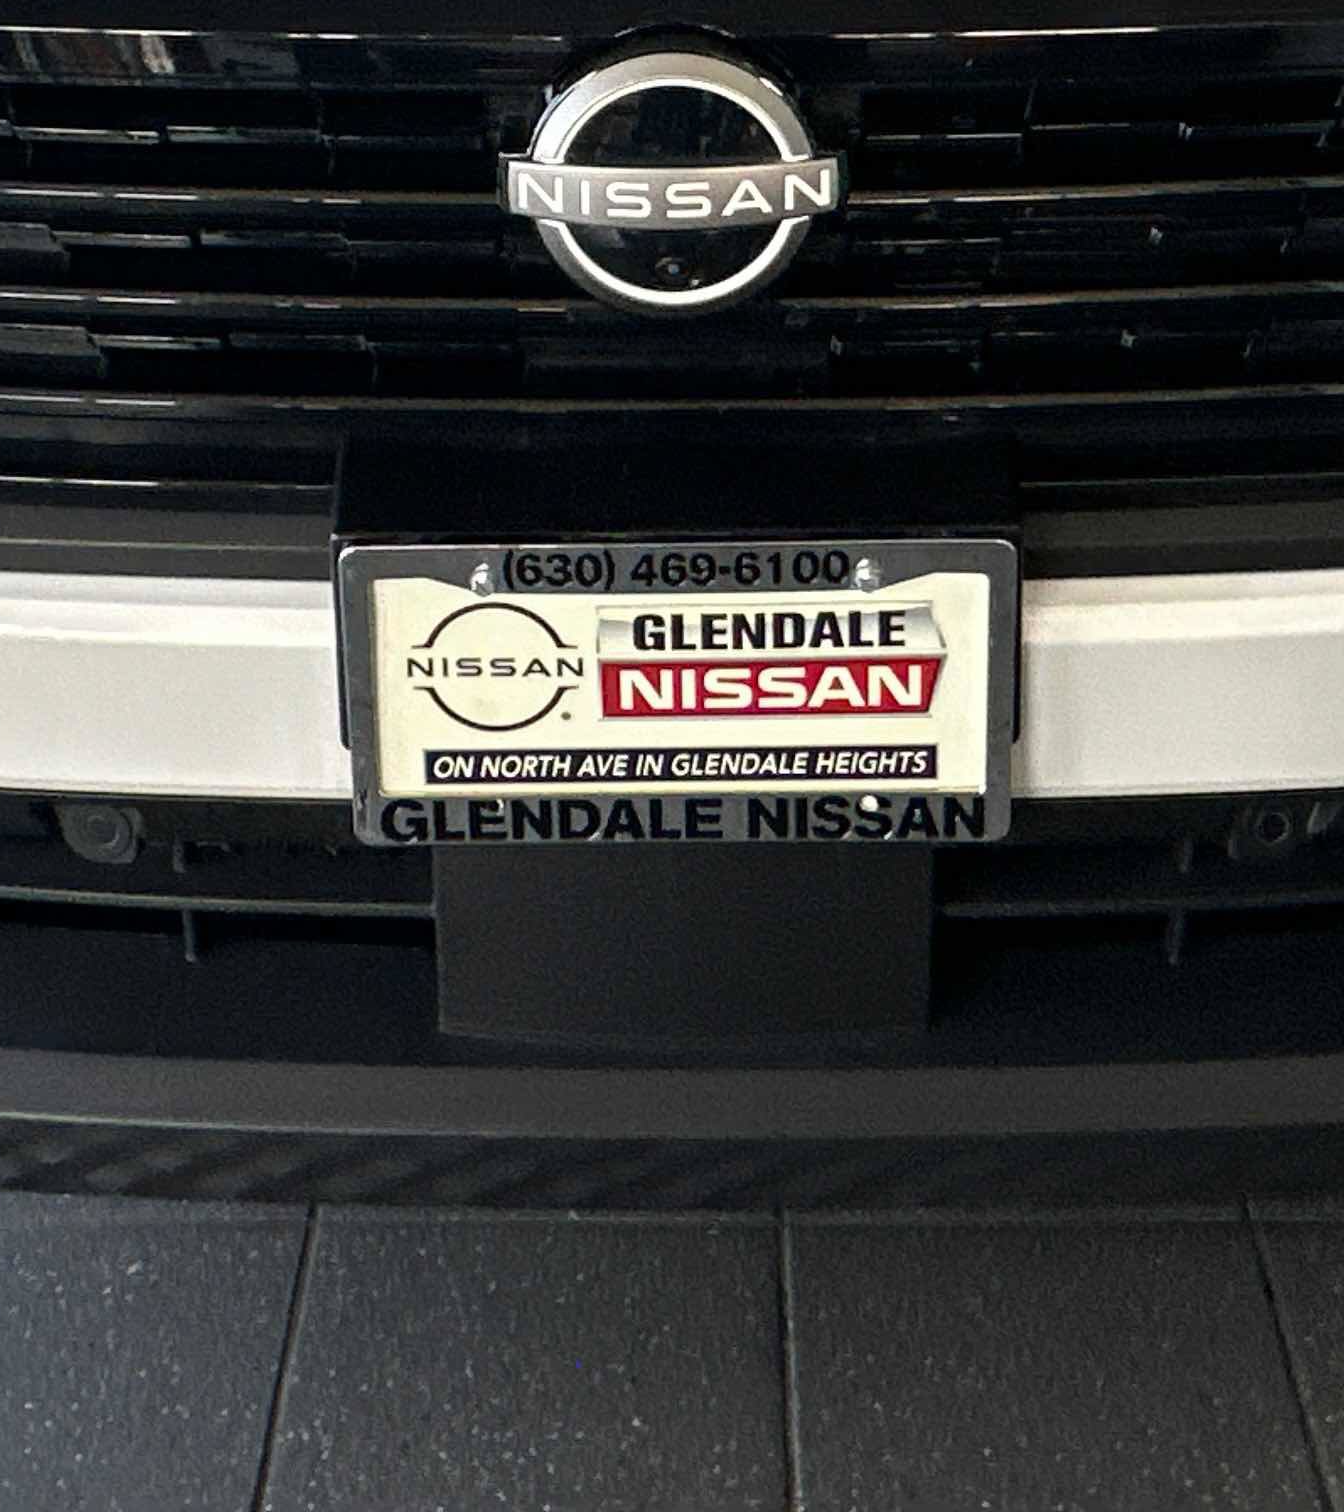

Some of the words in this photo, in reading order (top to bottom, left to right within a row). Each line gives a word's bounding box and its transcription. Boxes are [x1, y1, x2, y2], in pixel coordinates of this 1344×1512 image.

[517, 168, 832, 220] NISSAN
[503, 549, 615, 589] (630)
[630, 549, 850, 588] 469-6100
[632, 609, 906, 652] GLENDALE
[406, 657, 584, 678] NISSAN
[618, 664, 923, 711] NISSAN
[433, 755, 474, 779] ON
[479, 754, 570, 779] NORTH
[576, 753, 630, 778] AVE
[635, 753, 663, 777] IN
[670, 751, 809, 777] GLENDALE
[814, 749, 929, 775] HEIGHTS
[380, 797, 723, 842] GLENDALE
[747, 794, 986, 840] NISSAN
